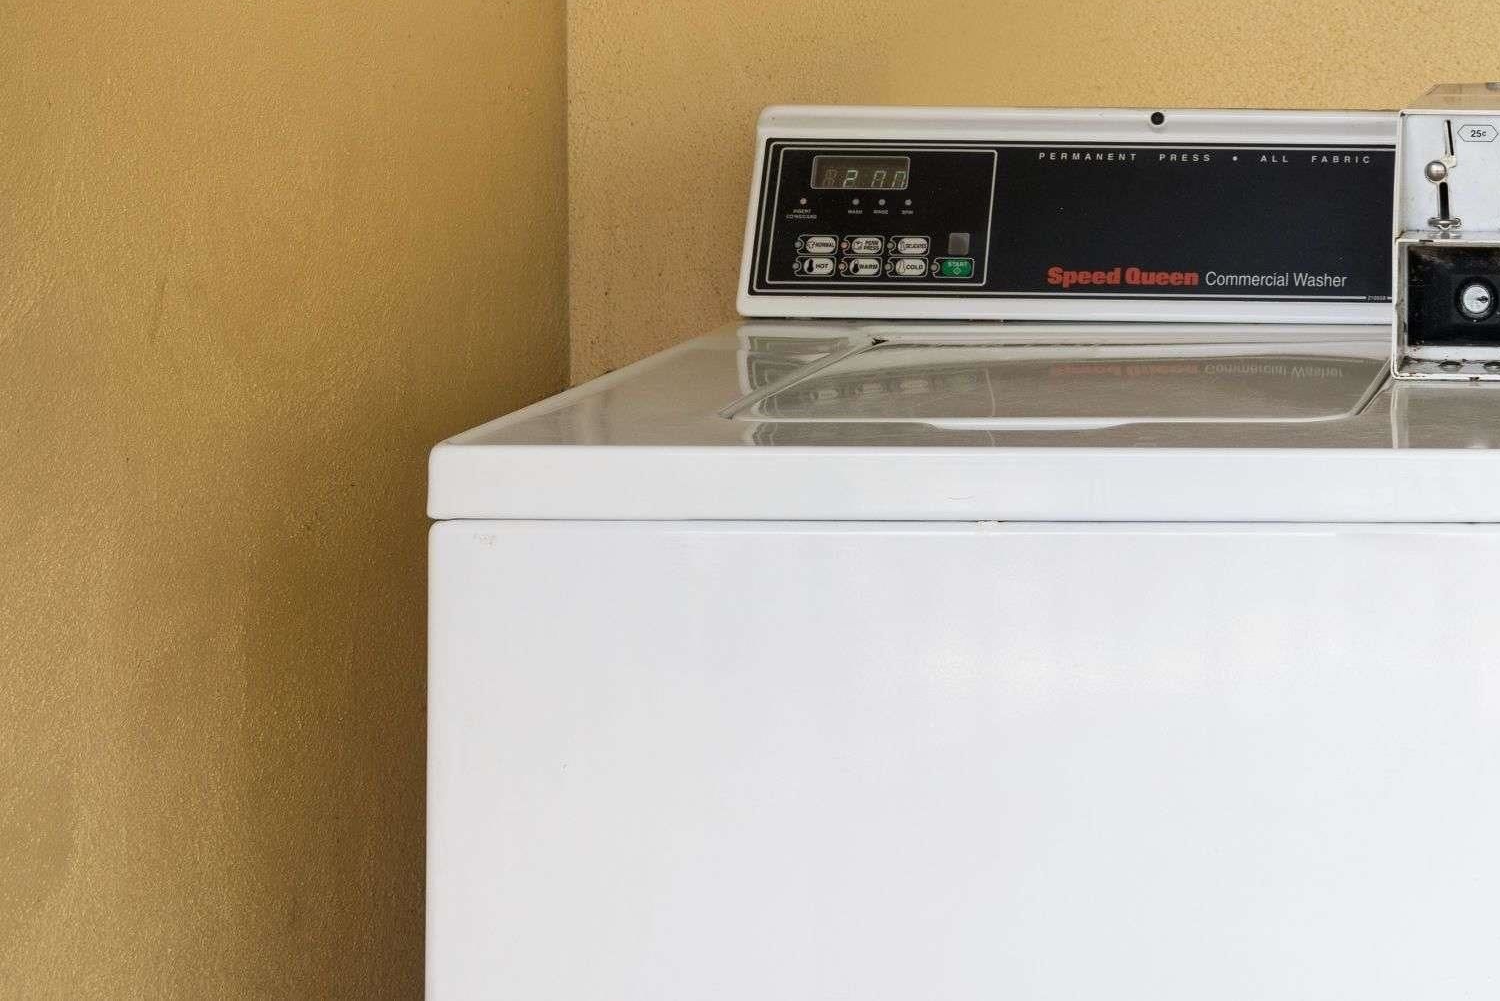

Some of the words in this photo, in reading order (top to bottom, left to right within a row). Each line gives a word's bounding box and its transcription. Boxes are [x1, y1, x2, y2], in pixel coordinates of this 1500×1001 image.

[1038, 152, 1138, 161] PERMANENT
[1158, 153, 1212, 162] PRESS
[1260, 155, 1290, 164] ALL
[1311, 155, 1371, 164] FABRIC
[1047, 266, 1121, 288] Speed
[1125, 266, 1200, 287] Queen
[1205, 271, 1289, 287] Commercial
[1293, 272, 1348, 288] Washer
